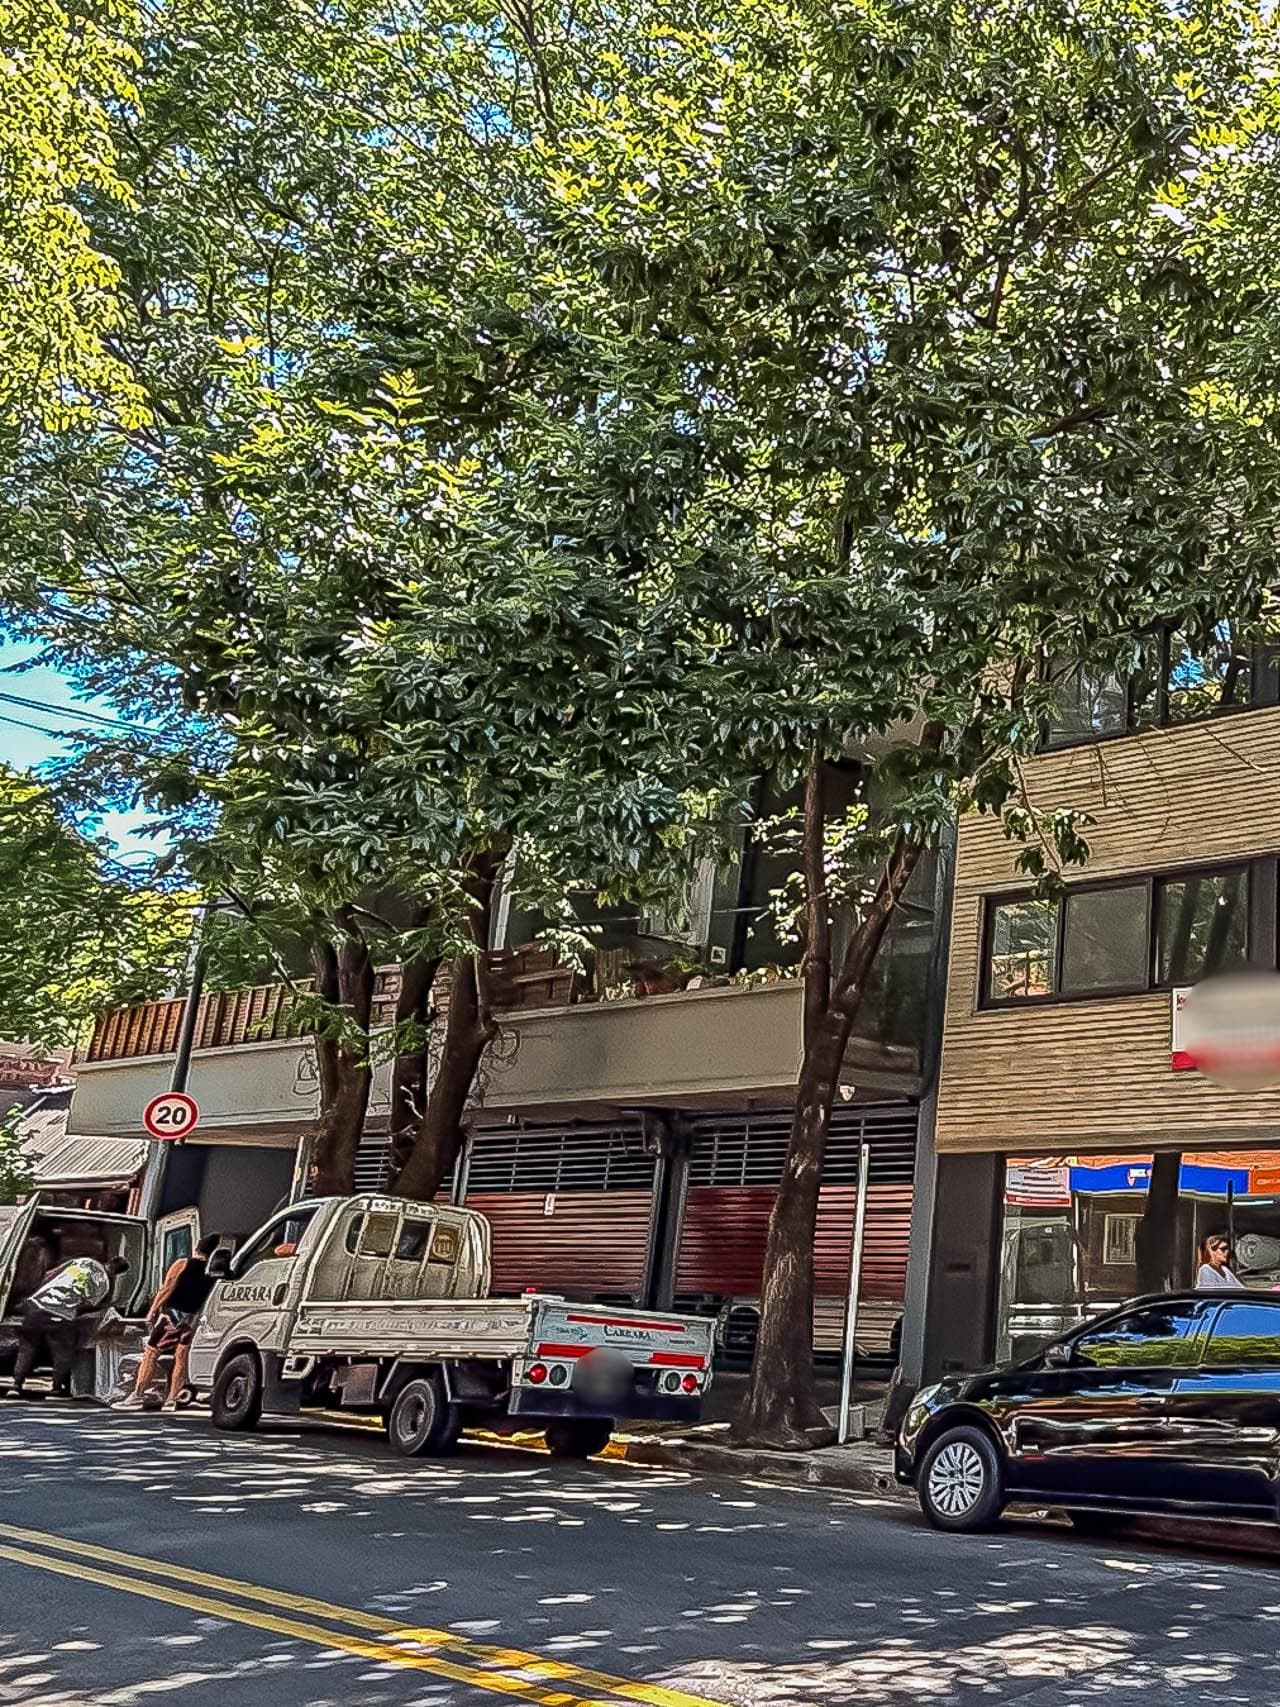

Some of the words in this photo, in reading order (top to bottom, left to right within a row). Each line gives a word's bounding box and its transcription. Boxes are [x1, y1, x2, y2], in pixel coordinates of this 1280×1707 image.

[155, 1105, 187, 1126] 20
[220, 1284, 272, 1301] CARRARA
[603, 1324, 653, 1341] CARRARA
